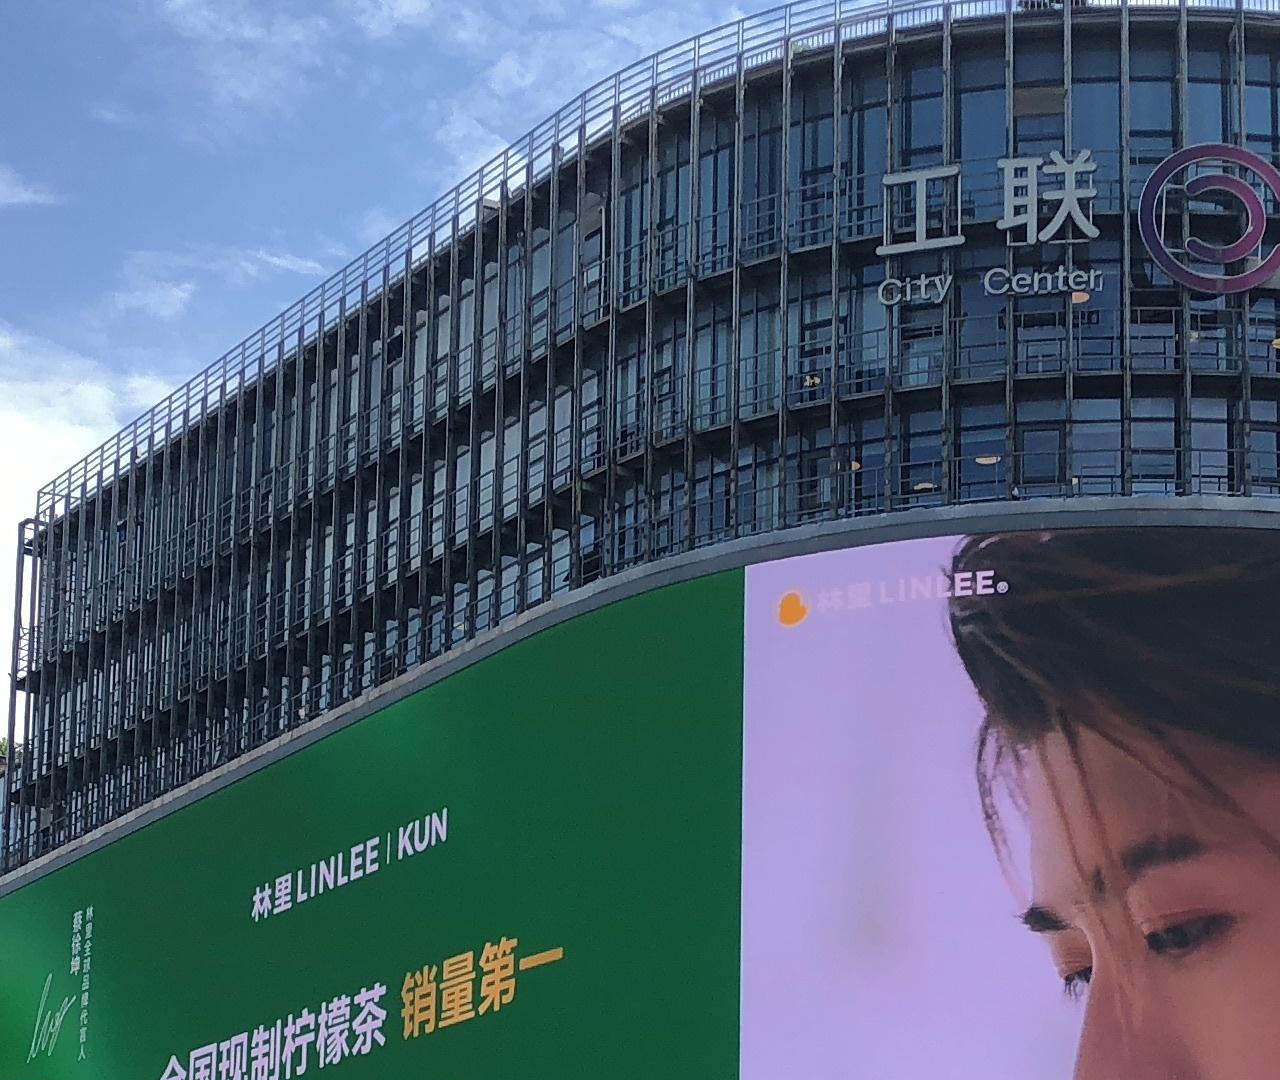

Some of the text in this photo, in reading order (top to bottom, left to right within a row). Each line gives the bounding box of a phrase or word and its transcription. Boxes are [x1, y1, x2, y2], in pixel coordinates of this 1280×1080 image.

[876, 149, 1100, 256] 工联
[878, 263, 1103, 306] City Center
[397, 807, 448, 860] KUN
[401, 936, 563, 1040] 销量第一
